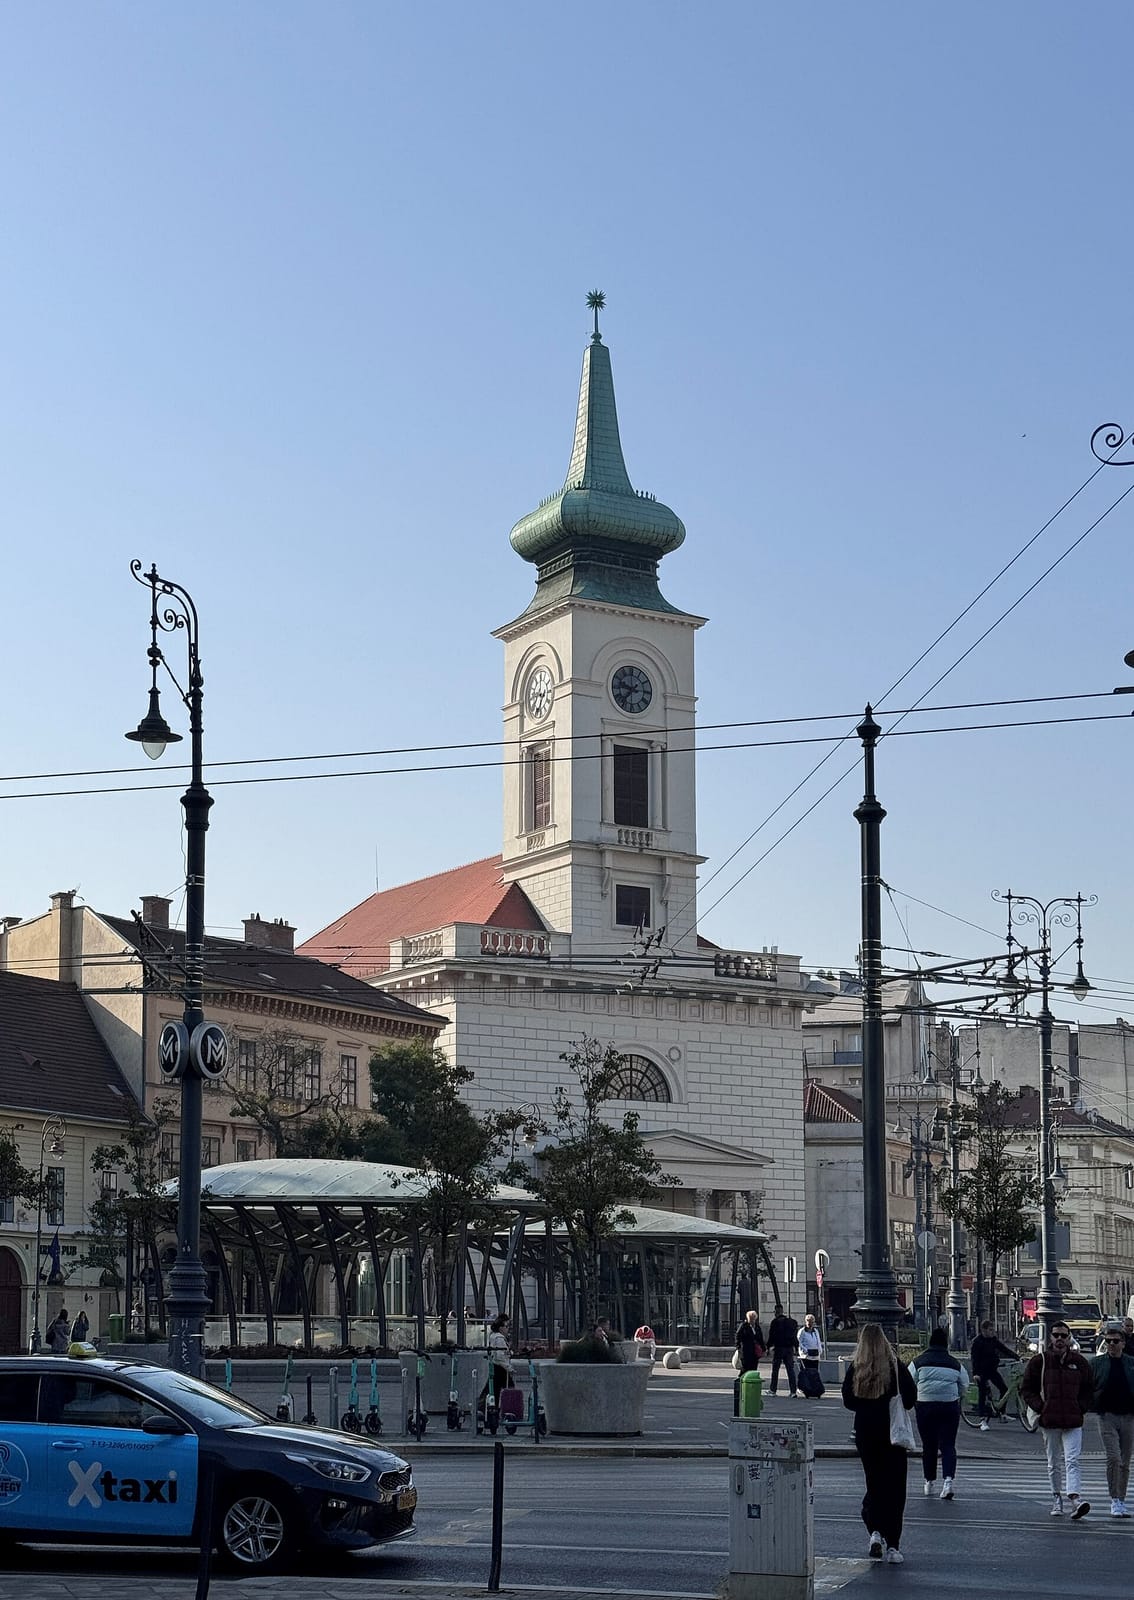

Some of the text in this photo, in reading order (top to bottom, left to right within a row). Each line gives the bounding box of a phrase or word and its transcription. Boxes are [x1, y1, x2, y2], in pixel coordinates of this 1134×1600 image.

[207, 1034, 224, 1066] M
[62, 1246, 77, 1256] PUB
[68, 1460, 178, 1508] Xtaxi
